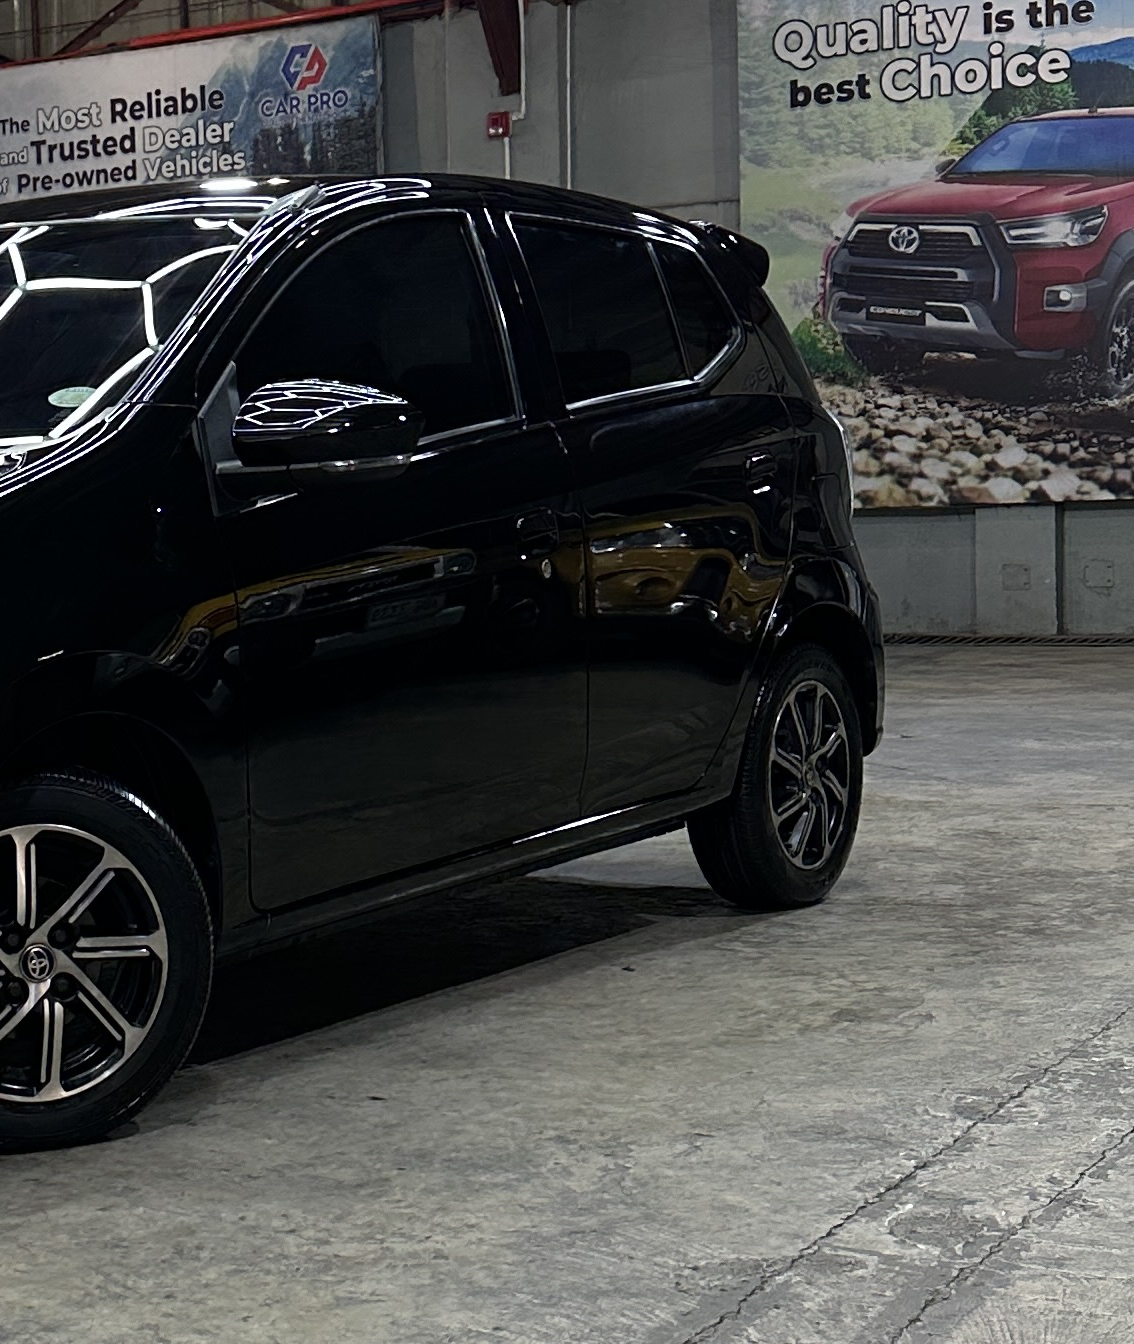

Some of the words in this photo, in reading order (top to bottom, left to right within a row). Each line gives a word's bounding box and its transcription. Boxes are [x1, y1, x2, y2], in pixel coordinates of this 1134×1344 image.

[772, 0, 968, 68] Quality
[982, 1, 1015, 36] is
[789, 73, 872, 109] best
[880, 42, 1072, 103] Choice
[0, 116, 30, 137] The
[36, 102, 101, 136] Most
[110, 85, 225, 124] Reliable
[260, 96, 301, 117] CAR
[308, 90, 349, 113] PRO
[0, 146, 29, 167] and
[31, 126, 136, 165] Trusted
[142, 119, 235, 153] Dealer
[17, 159, 137, 194] Pre-owned
[143, 149, 246, 182] Vehicles
